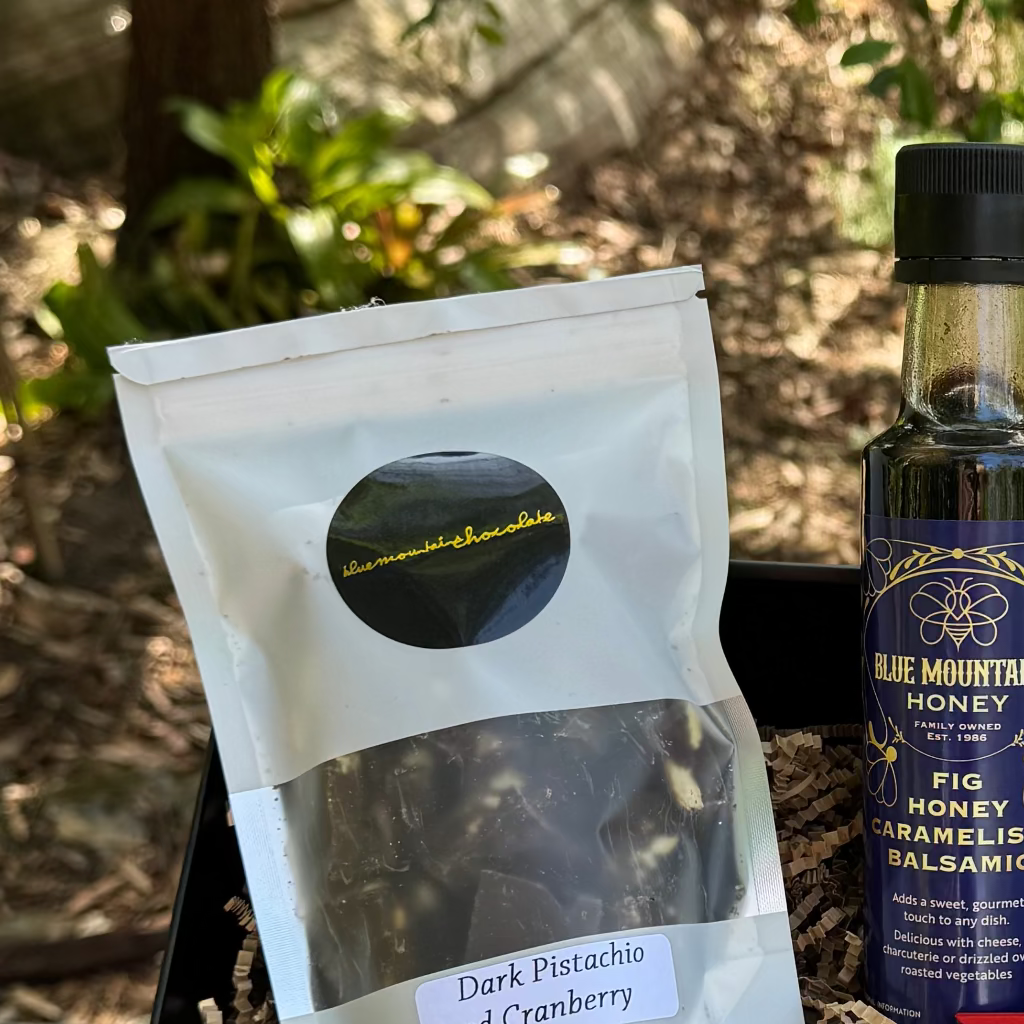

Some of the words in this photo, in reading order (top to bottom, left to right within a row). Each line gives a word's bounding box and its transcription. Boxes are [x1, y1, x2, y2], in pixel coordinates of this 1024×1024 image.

[875, 653, 915, 684] BLUE
[907, 692, 1009, 712] HONEY
[914, 721, 954, 730] FAMILY
[959, 723, 1001, 731] OWNED
[957, 734, 987, 742] 1986
[932, 772, 983, 791] FIG
[908, 798, 1009, 818] HONEY
[893, 892, 918, 906] Adds
[920, 898, 927, 907] a
[930, 899, 969, 911] sweet,
[972, 898, 1024, 912] gourmet
[904, 911, 935, 924] touch
[939, 915, 952, 926] to
[955, 916, 978, 928] any
[981, 915, 1010, 926] dish.
[894, 930, 944, 946] Delicious
[946, 935, 974, 948] with
[977, 936, 1022, 948] cheese,
[882, 944, 940, 963] charcuterie
[942, 954, 956, 964] or
[959, 952, 1008, 964] drizzled
[458, 963, 525, 1001] Dark
[532, 942, 645, 982] Pistachio
[900, 965, 943, 979] roasted
[946, 969, 1013, 983] vegetables
